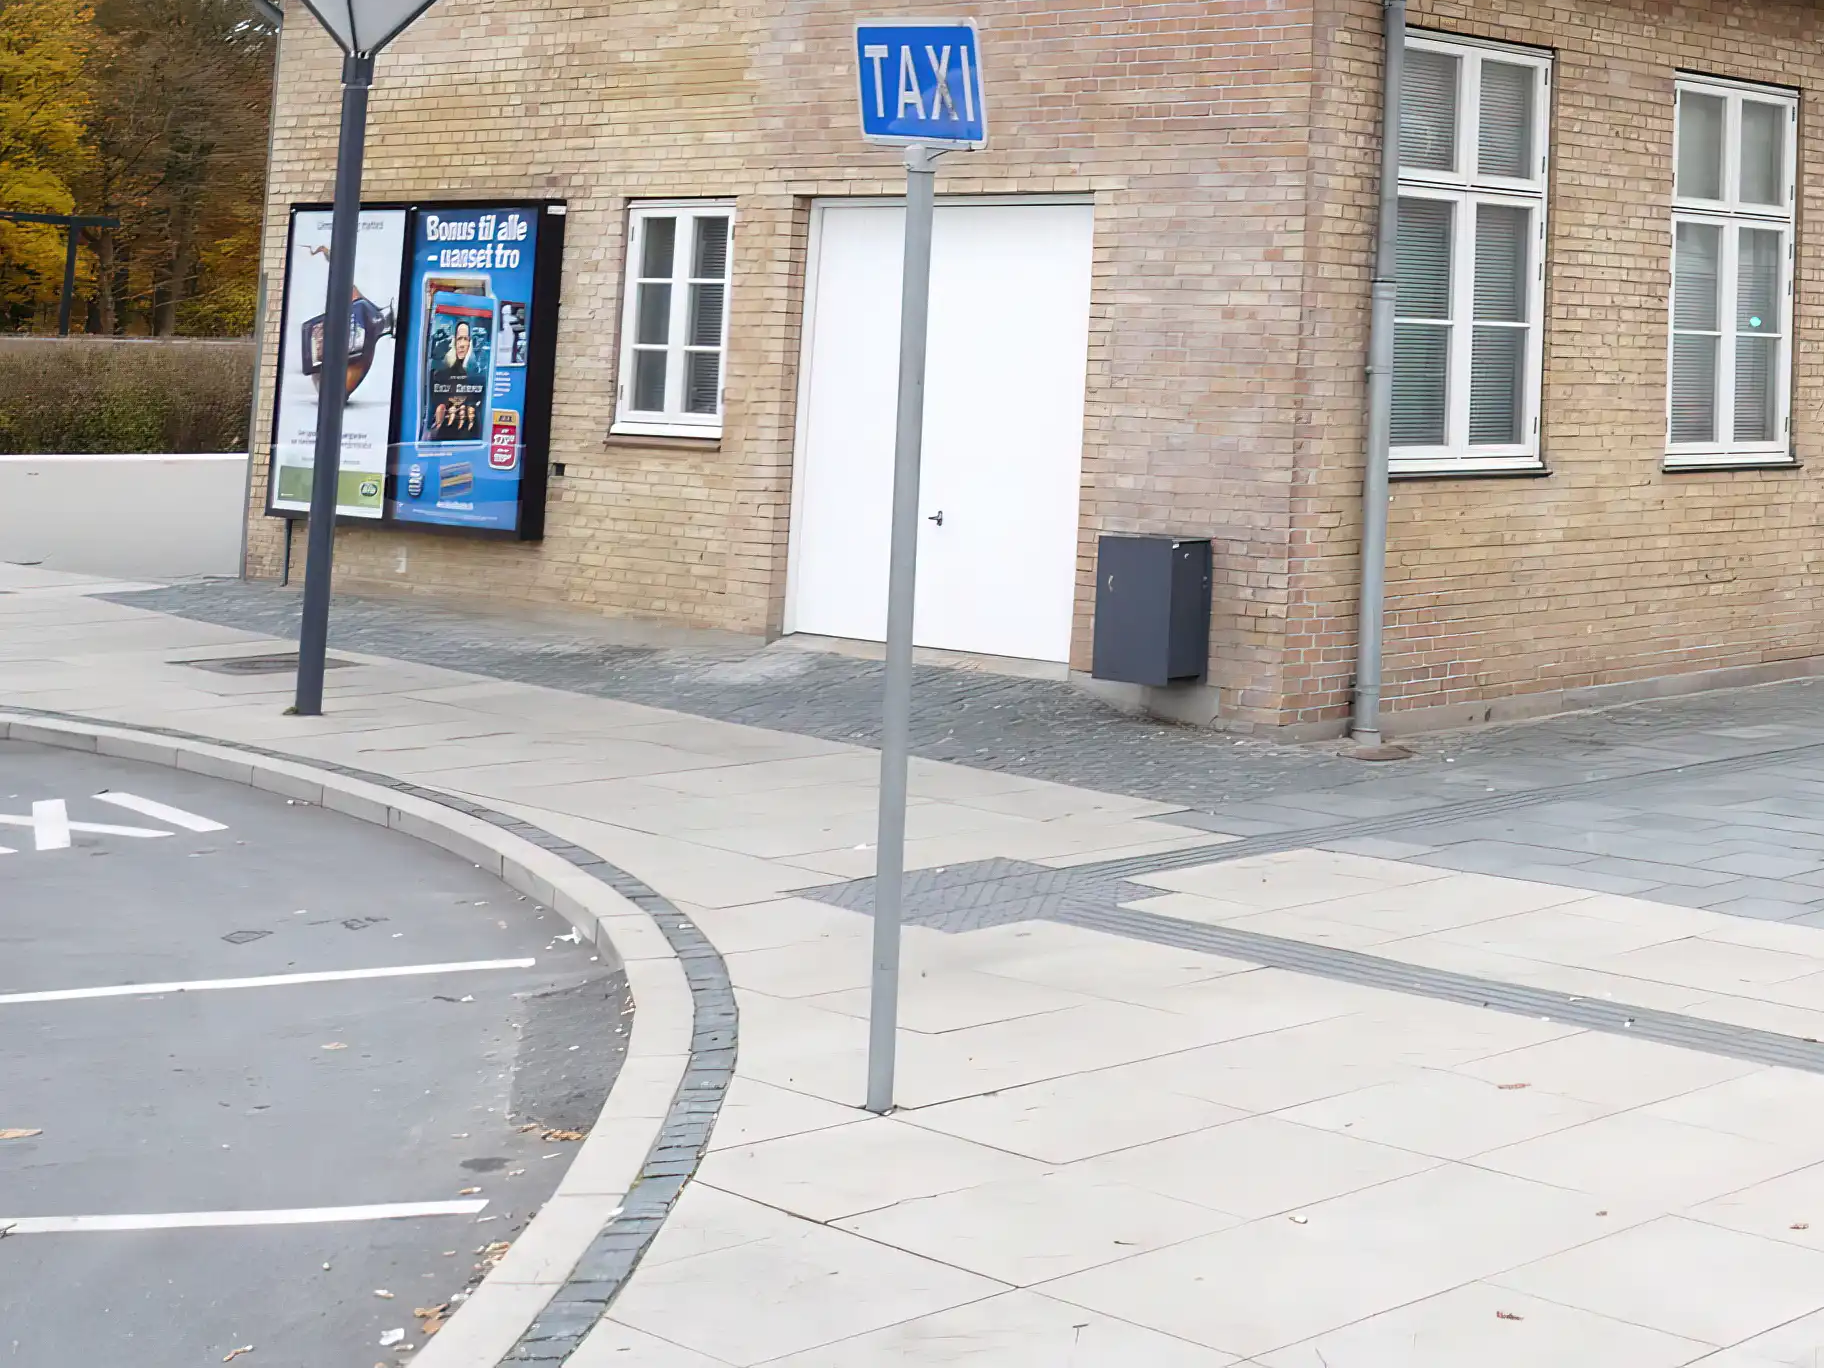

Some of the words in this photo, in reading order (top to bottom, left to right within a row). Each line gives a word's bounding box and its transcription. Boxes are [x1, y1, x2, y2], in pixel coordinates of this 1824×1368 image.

[863, 44, 975, 122] TAXI
[426, 215, 476, 241] Bonus
[478, 214, 496, 241] til
[497, 214, 528, 241] alle
[440, 243, 494, 268] uanset
[495, 243, 520, 269] tro
